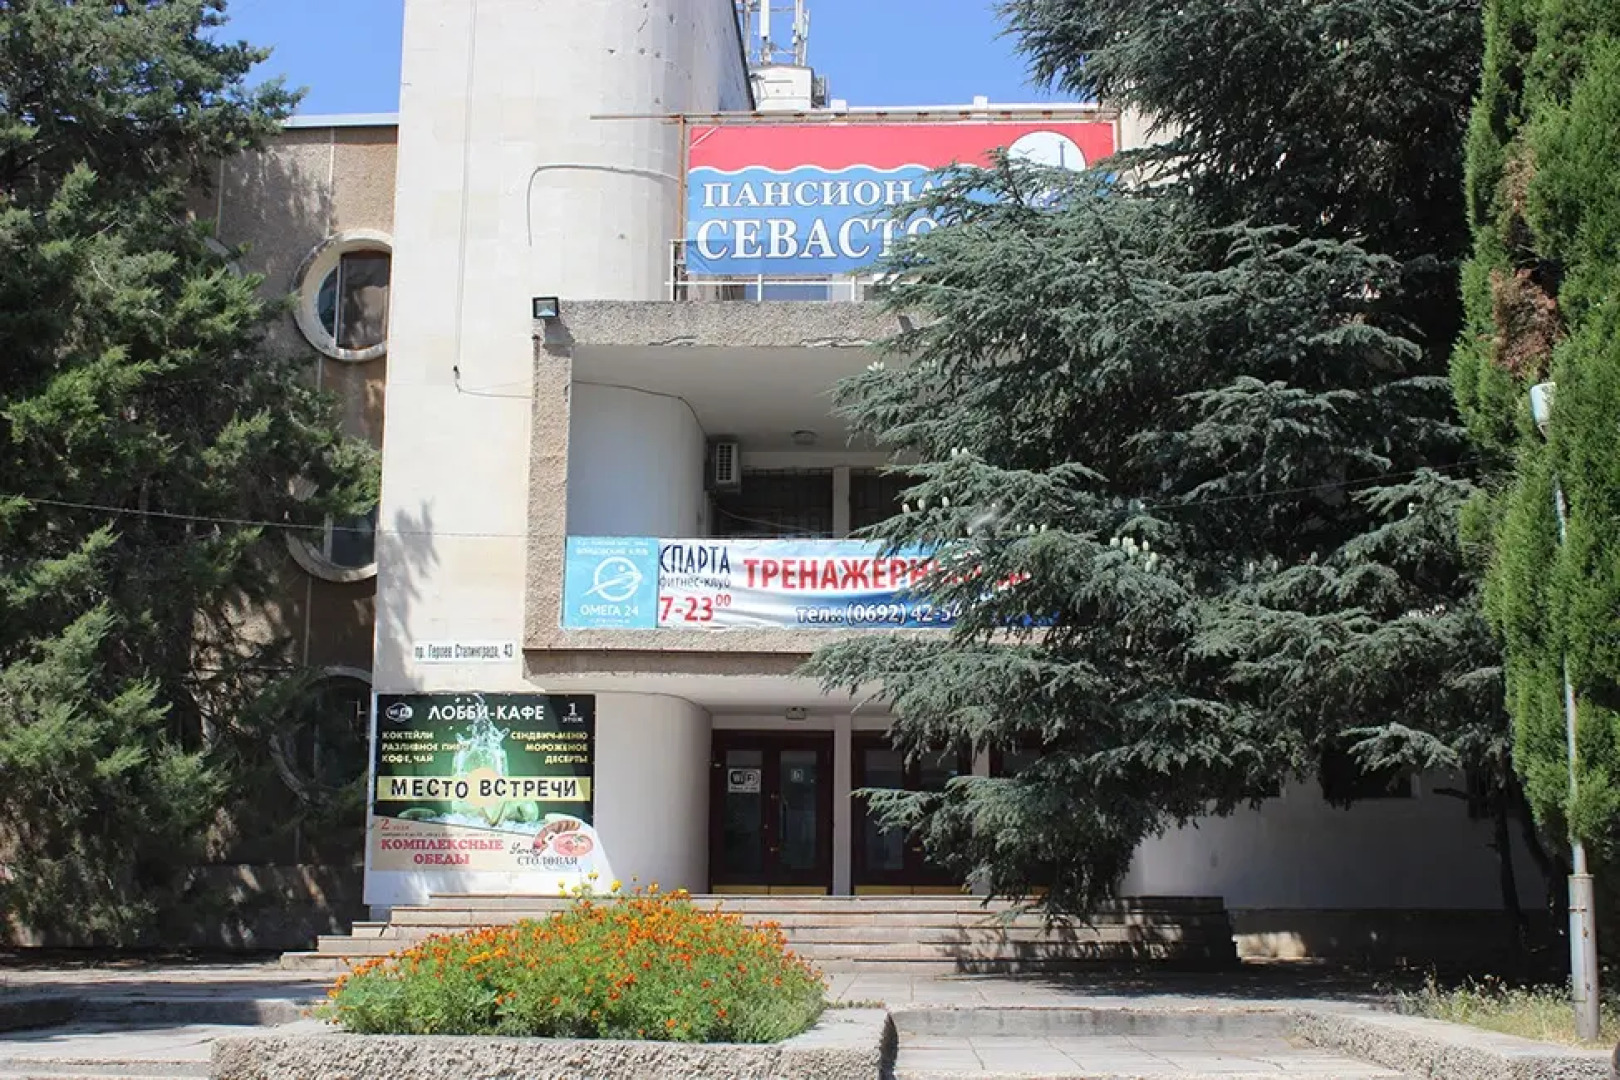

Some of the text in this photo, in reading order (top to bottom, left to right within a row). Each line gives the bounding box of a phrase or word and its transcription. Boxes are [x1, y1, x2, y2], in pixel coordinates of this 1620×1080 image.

[703, 181, 956, 207] ПАНСИОНА
[660, 545, 730, 574] СПАРТА
[580, 604, 639, 617] ОМЕГА 24
[847, 603, 906, 625] (0692)
[428, 644, 453, 660] Героев
[503, 643, 513, 658] 43
[428, 705, 544, 720] ЛОББИ-КАФЕ
[568, 702, 577, 716] 1
[382, 730, 434, 740] КОКТЕЙЛИ
[382, 742, 438, 751] РАЗЛИВНОЕ
[525, 743, 588, 752] МОРОЖЕНОЕ
[413, 753, 434, 762] ЧАЙ
[545, 755, 588, 765] ДЕСЕРТЫ
[391, 778, 577, 798] МЕСТО ВСТРЕЧИ
[381, 818, 390, 830] 2
[381, 839, 505, 850] КОМПЛЕКСНЫЕ
[413, 854, 470, 866] ОБЕДЫ
[517, 856, 578, 866] СТОЛОВАЯ
